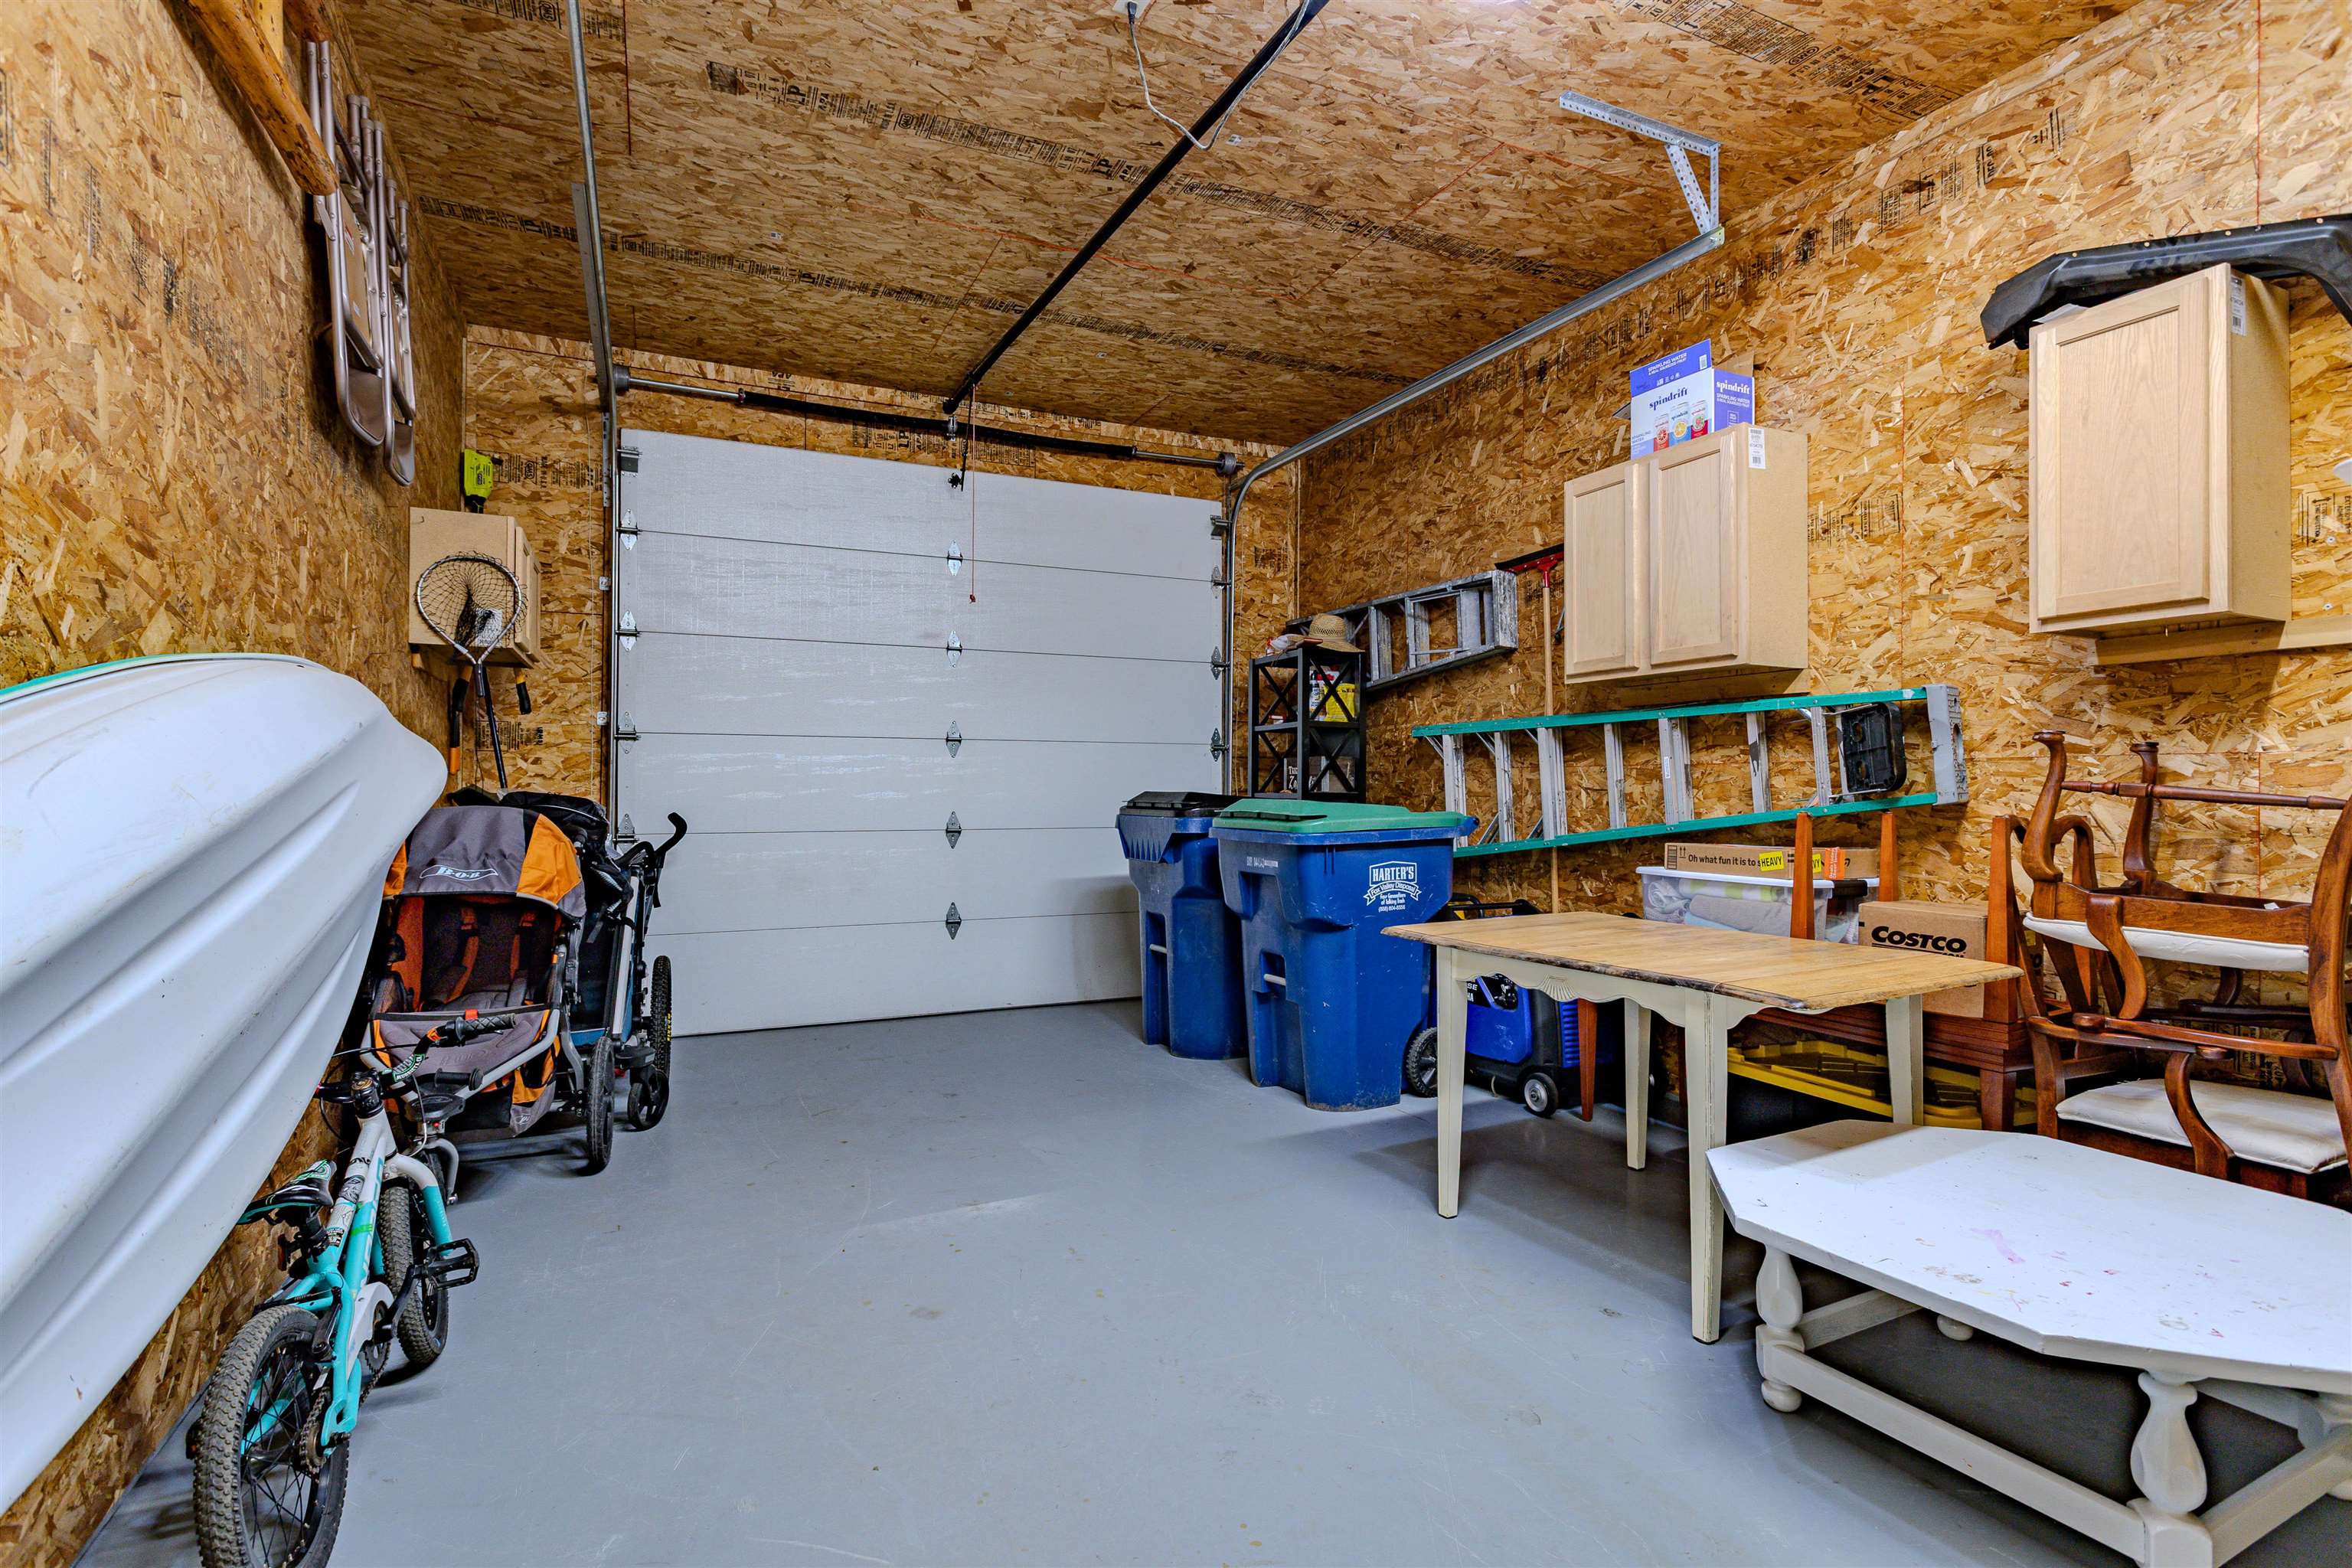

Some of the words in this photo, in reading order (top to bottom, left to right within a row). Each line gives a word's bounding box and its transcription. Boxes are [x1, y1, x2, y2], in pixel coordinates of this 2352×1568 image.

[1861, 75, 1896, 96] LP
[786, 84, 807, 106] LP
[1092, 158, 1113, 175] LP
[1119, 164, 1134, 181] APA
[1716, 380, 1750, 395] spindrift
[1649, 387, 1688, 410] spindrift
[1688, 854, 1698, 863] Oh
[1699, 854, 1717, 864] what
[1719, 856, 1731, 865] fun
[1732, 857, 1739, 865] it
[1740, 857, 1746, 866] is
[1747, 858, 1756, 867] to
[1761, 856, 1782, 867] HEAVY
[1372, 866, 1414, 882] HARTER'S
[1370, 887, 1380, 896] Fox
[1380, 883, 1395, 891] Valley
[1395, 882, 1416, 893] Disposal
[1871, 926, 1967, 954] COSTCO
